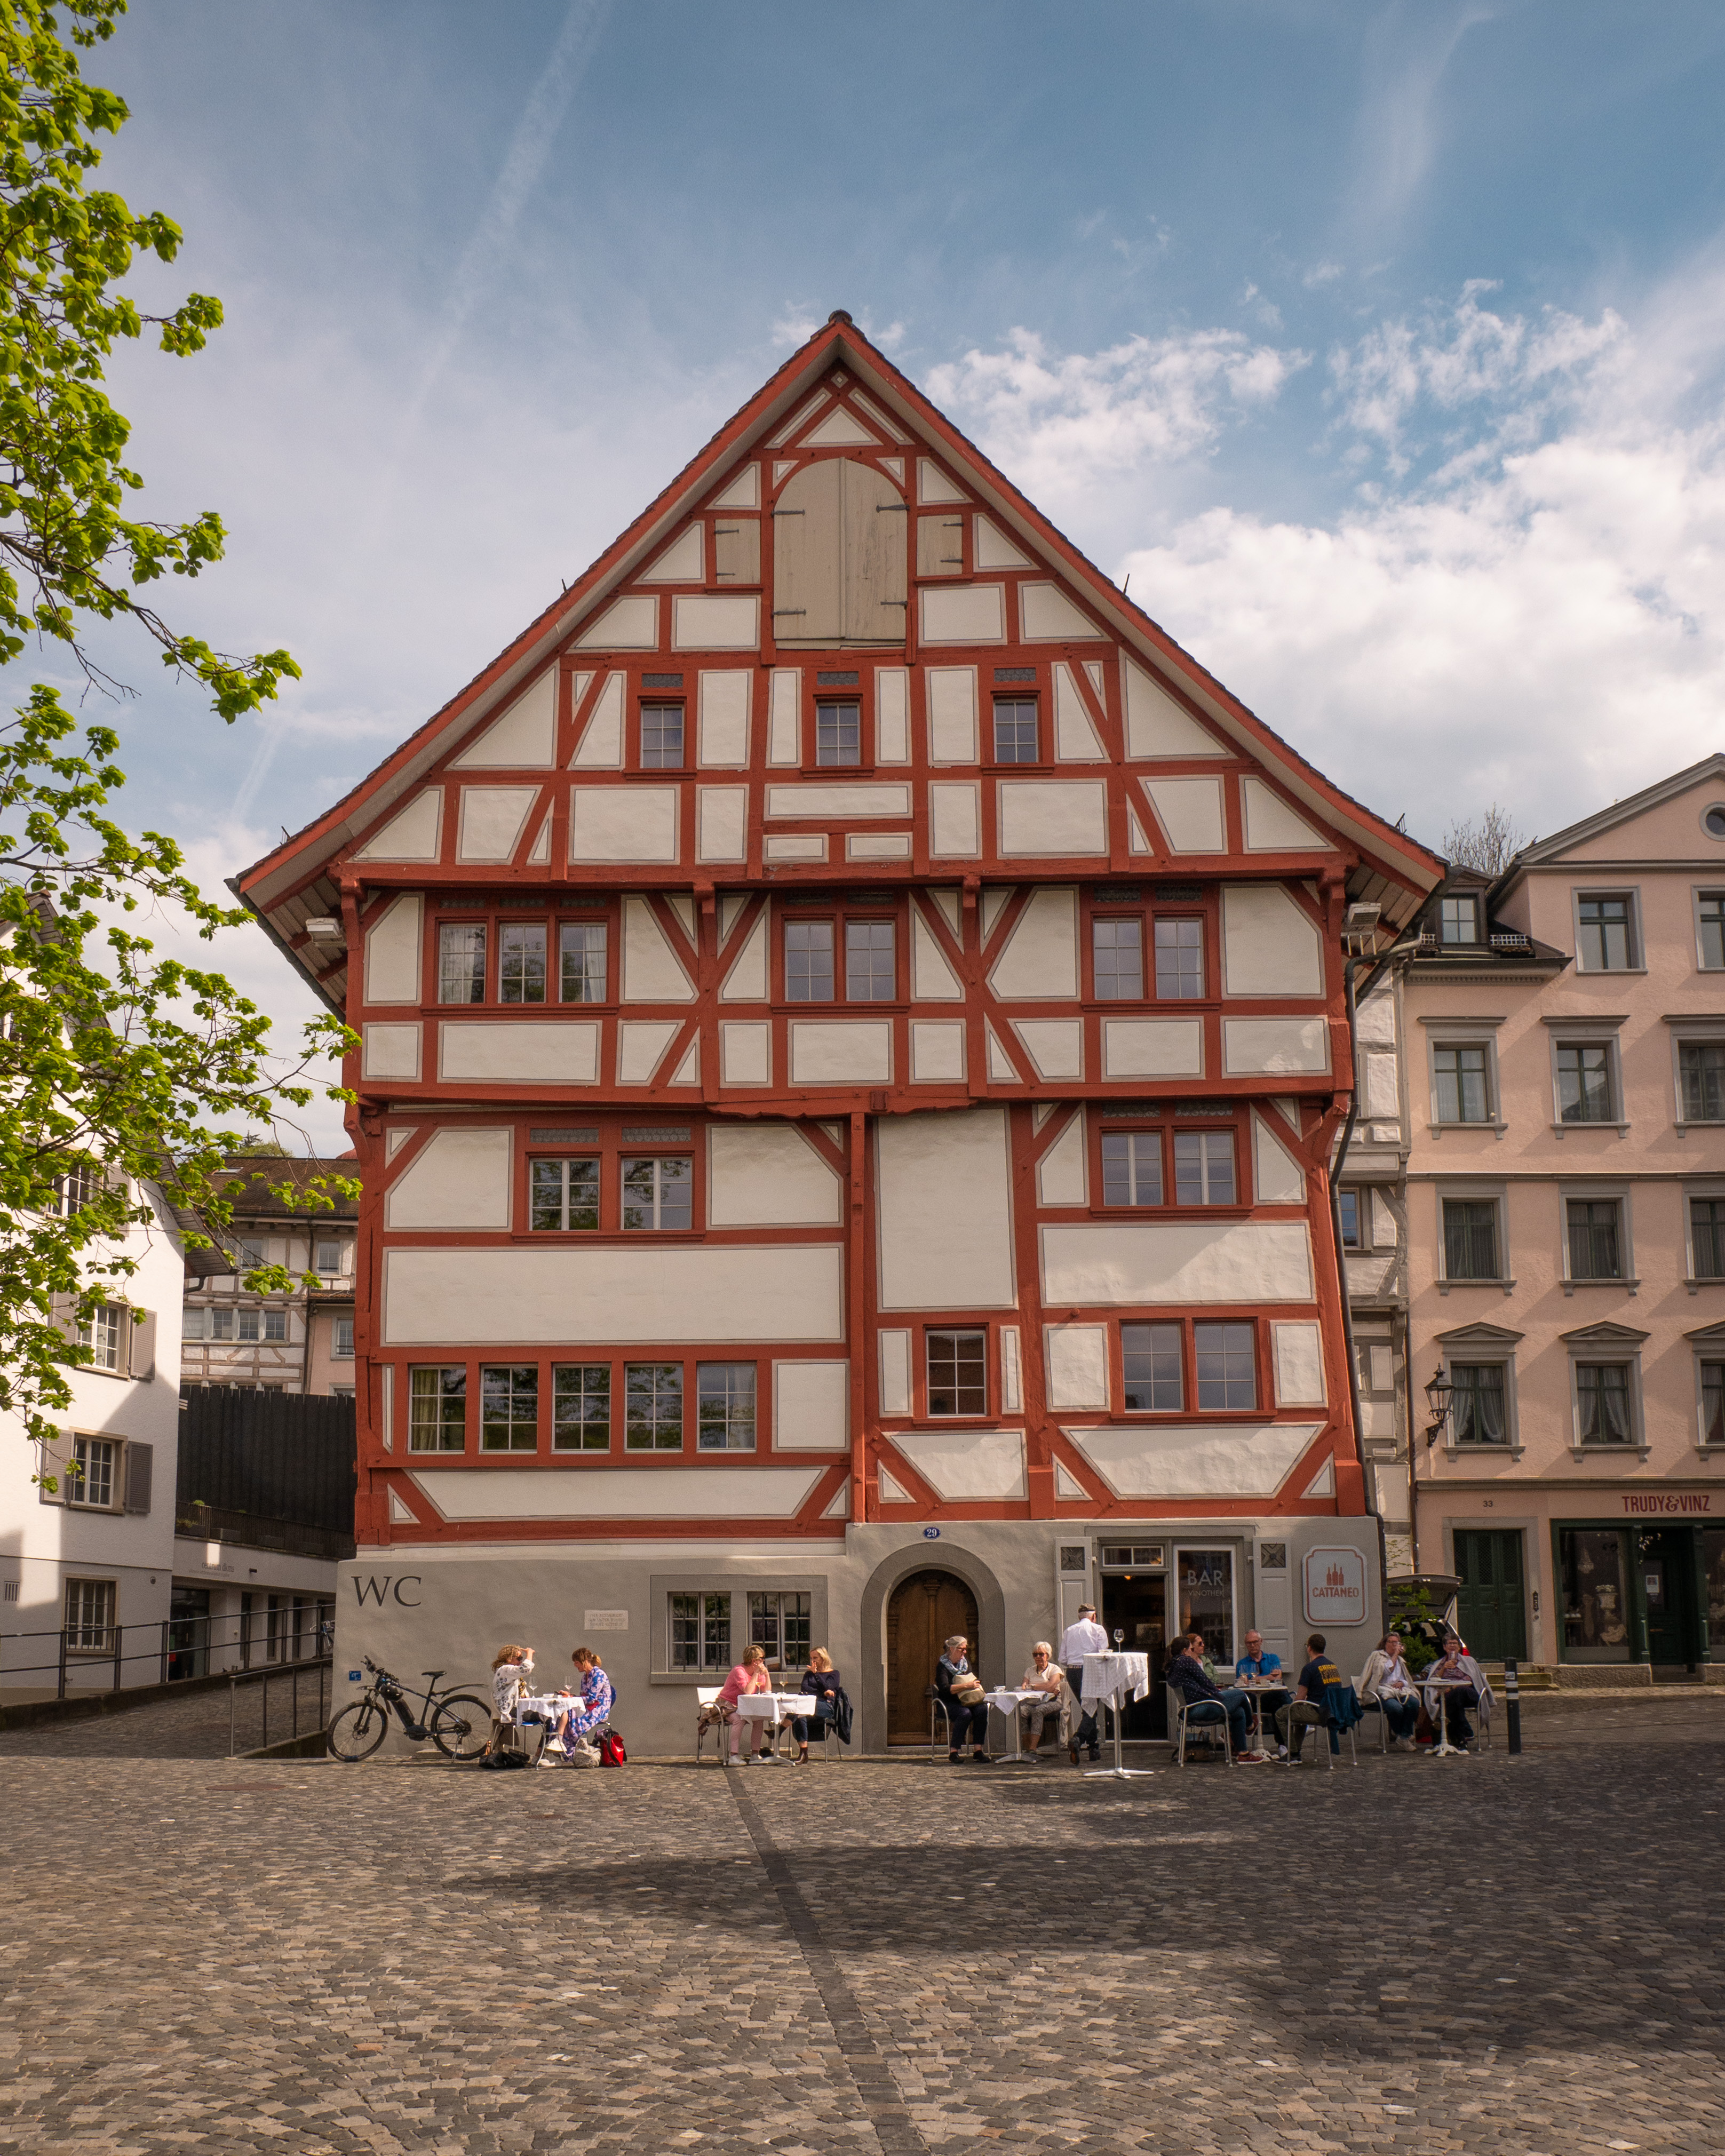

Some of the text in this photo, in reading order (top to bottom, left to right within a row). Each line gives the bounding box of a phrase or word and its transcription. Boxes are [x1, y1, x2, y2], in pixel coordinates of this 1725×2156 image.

[1622, 1495, 1711, 1512] TRUDY&VINZ
[927, 1528, 937, 1537] 29
[1188, 1570, 1223, 1586] BAR
[351, 1576, 422, 1607] WC
[1313, 1587, 1359, 1597] CATTANEO
